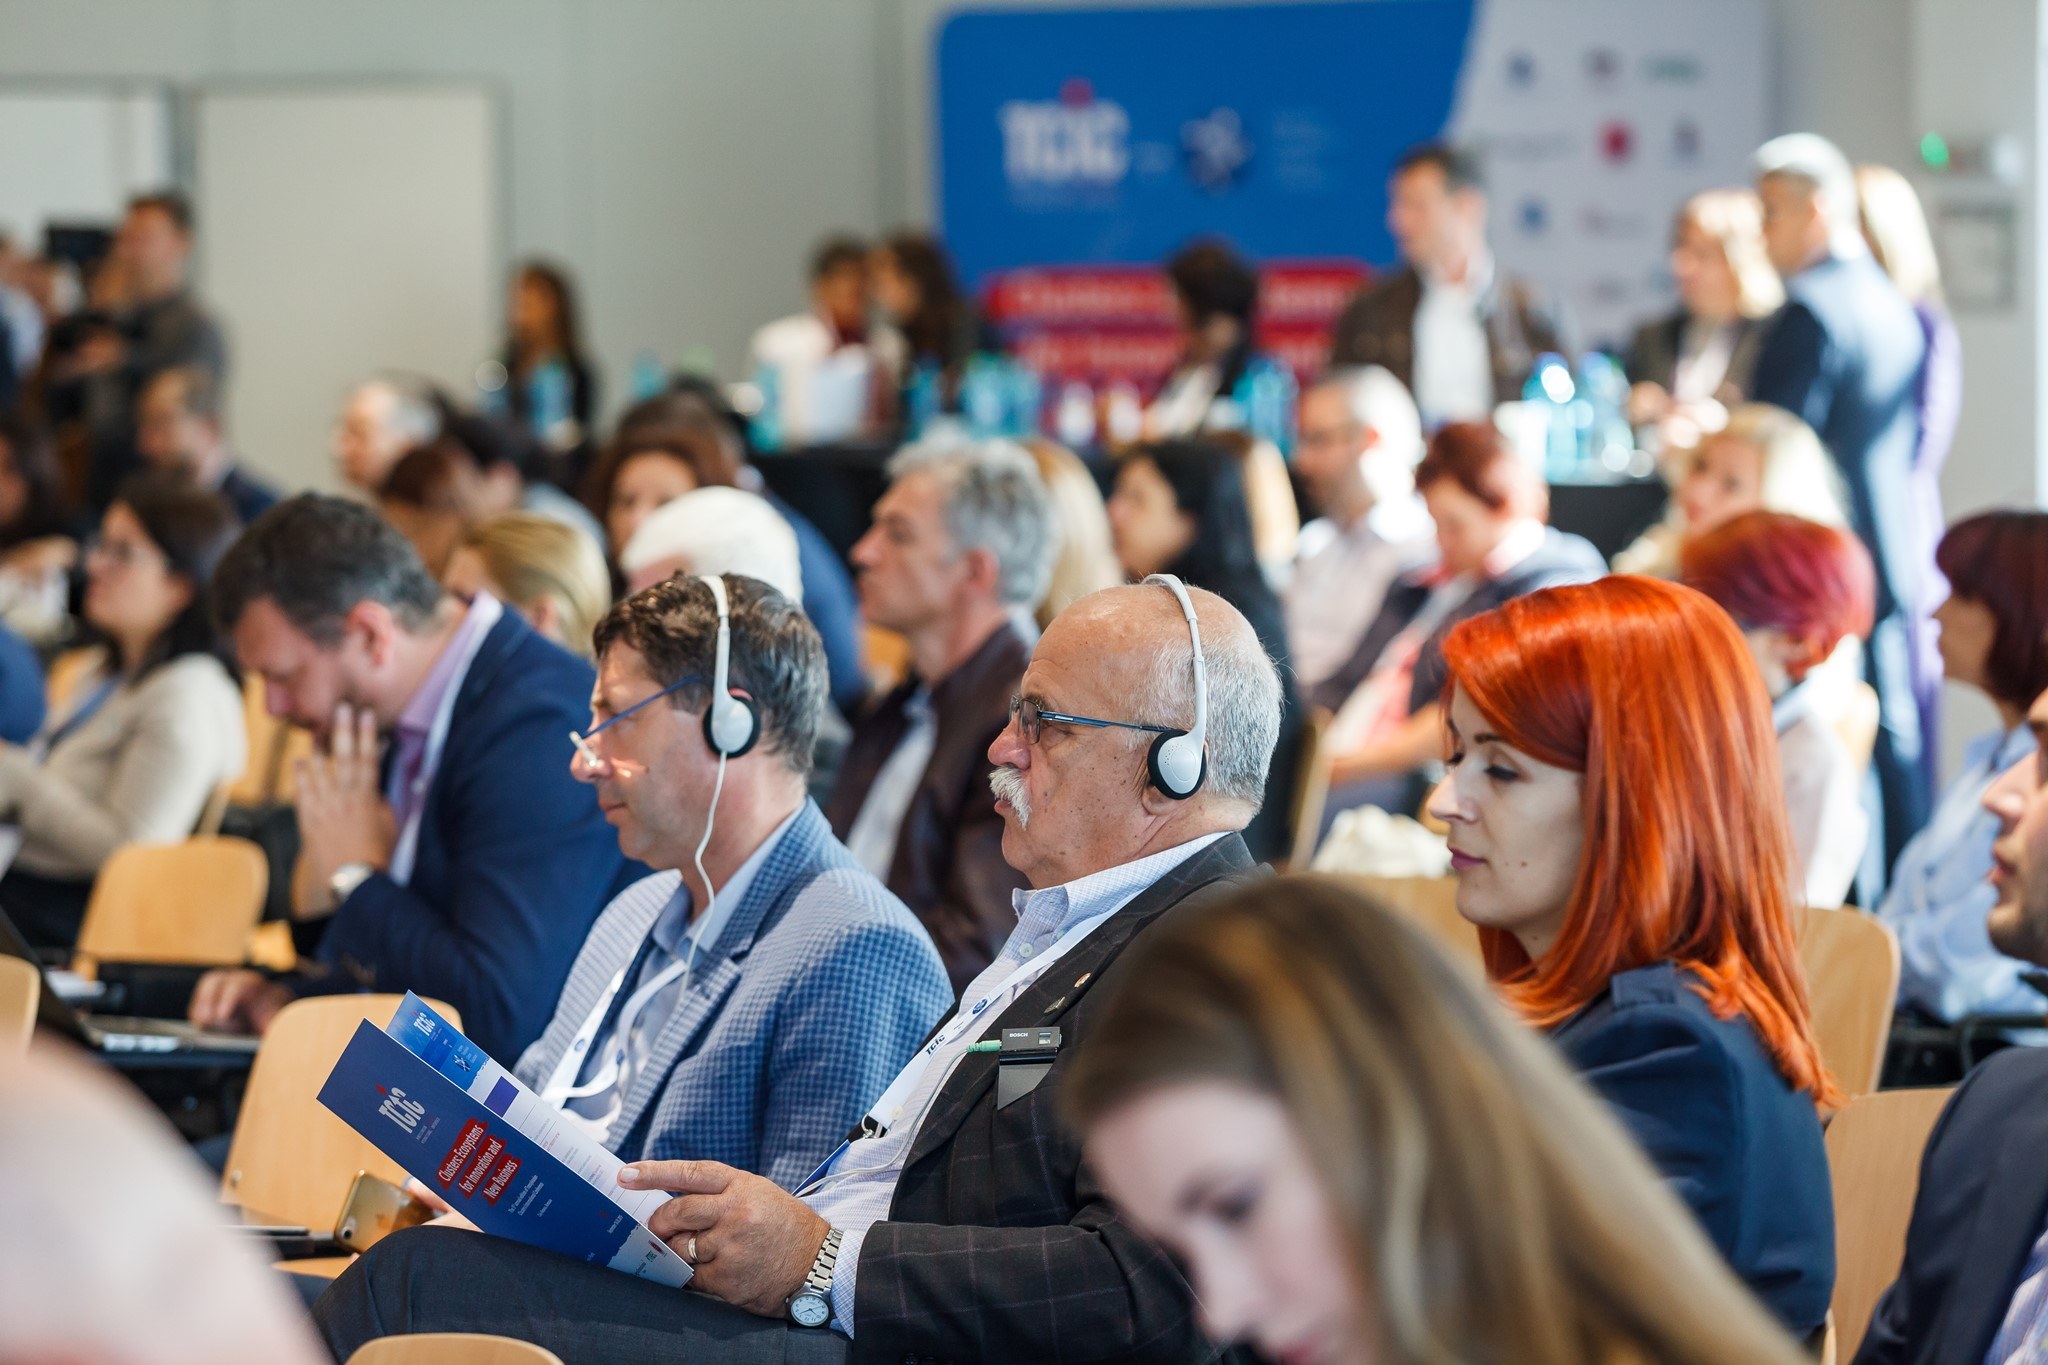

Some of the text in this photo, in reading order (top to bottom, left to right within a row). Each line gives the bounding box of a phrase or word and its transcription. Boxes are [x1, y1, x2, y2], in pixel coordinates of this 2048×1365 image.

[438, 1124, 485, 1182] Clusters: Ecosystems
[458, 1137, 503, 1193] for Innovation and
[483, 1159, 518, 1200] New Business
